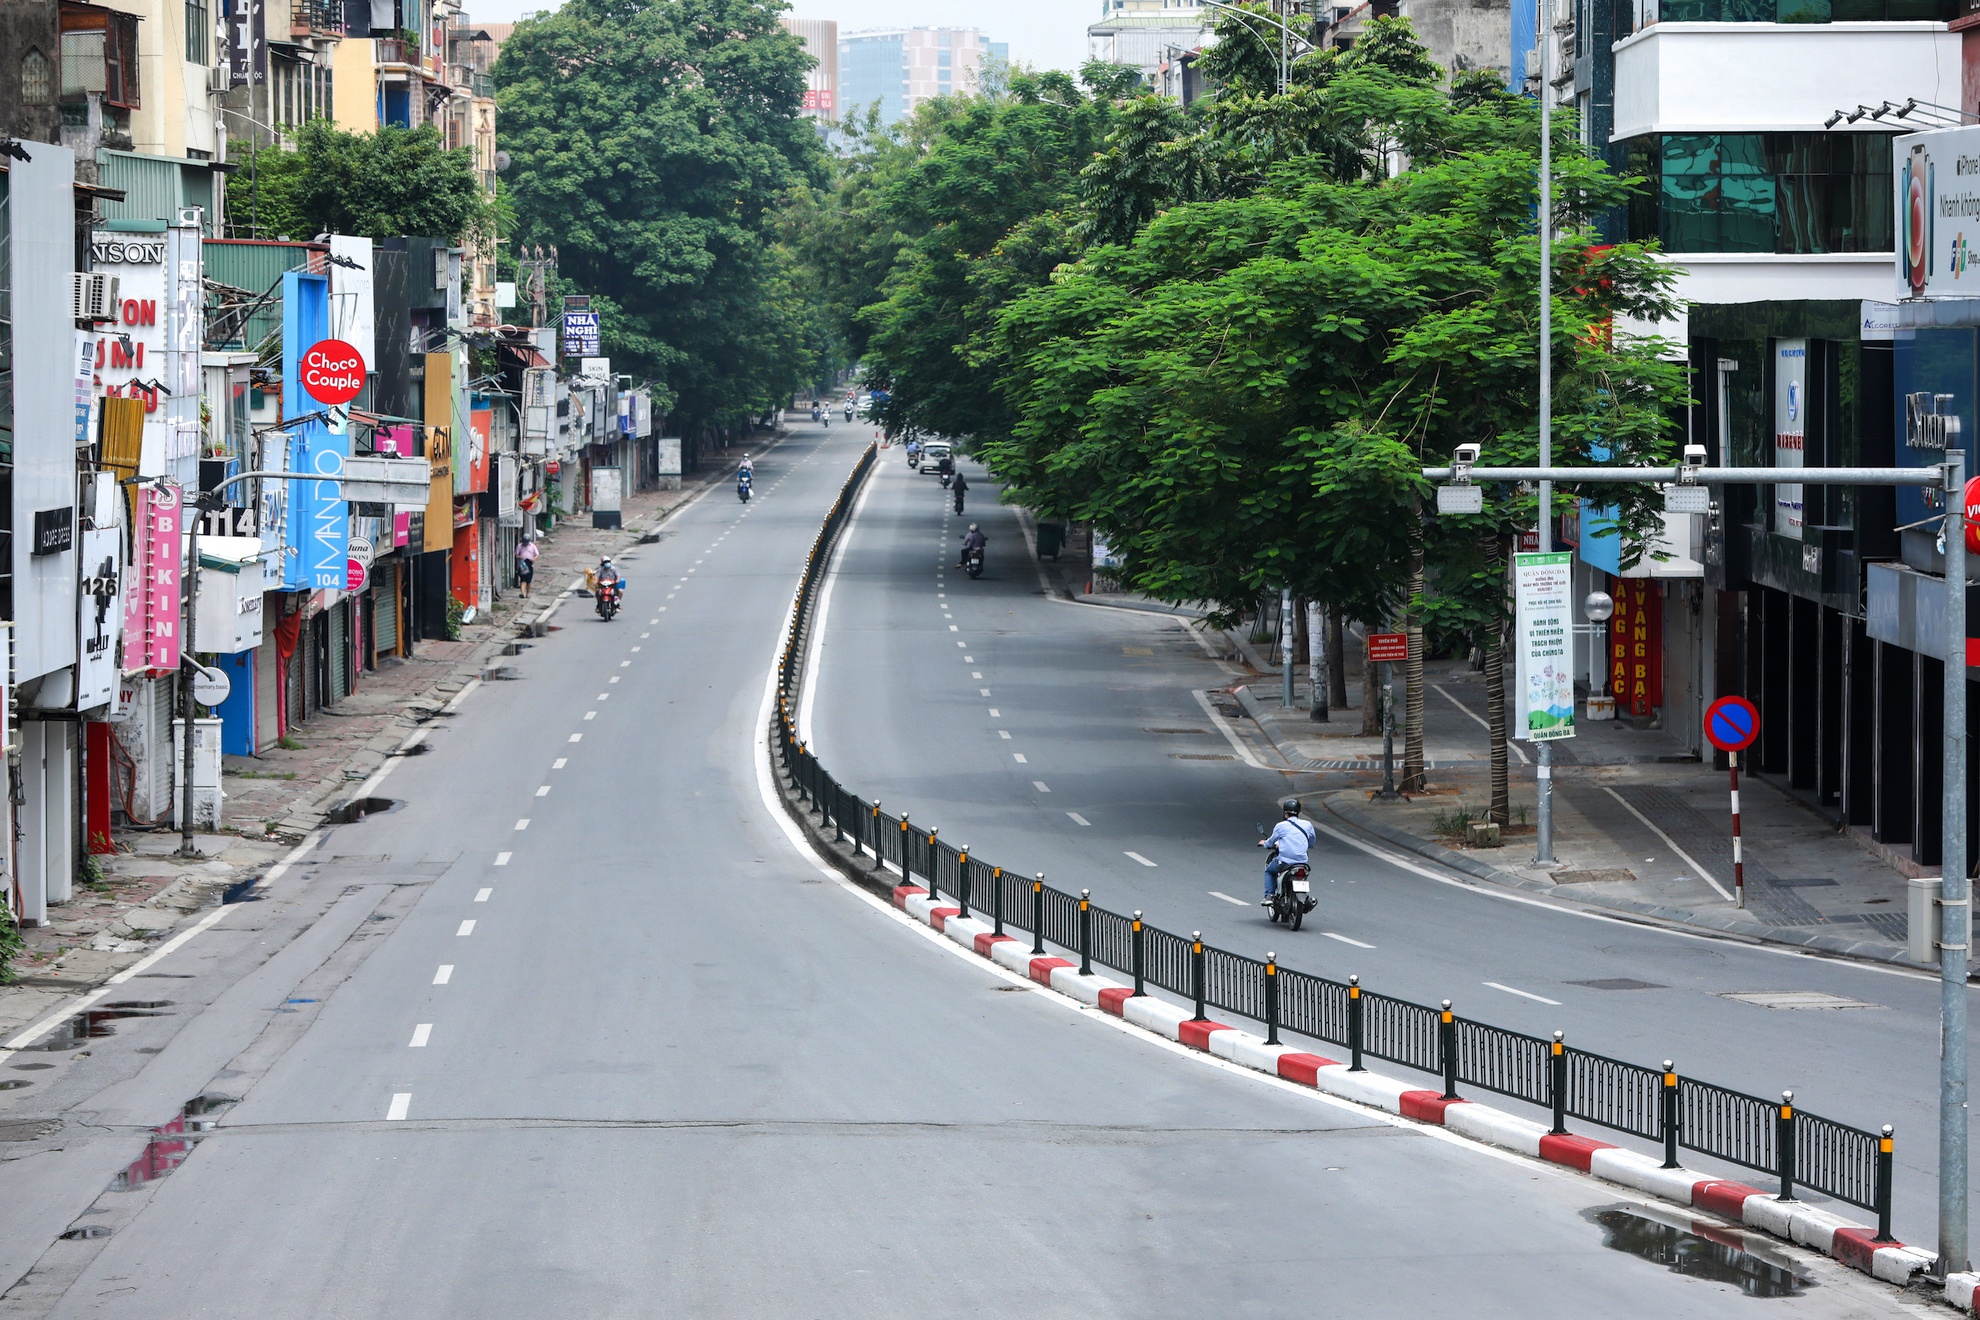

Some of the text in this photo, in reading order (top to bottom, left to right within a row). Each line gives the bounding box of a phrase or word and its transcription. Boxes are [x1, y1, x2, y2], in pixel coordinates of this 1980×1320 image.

[821, 100, 832, 108] QLO
[1940, 191, 1980, 222] Nhanh không
[308, 352, 358, 371] Choco
[306, 370, 361, 391] Couple
[205, 507, 257, 537] 114
[314, 449, 343, 570] MANDO
[82, 576, 117, 595] 126
[156, 517, 173, 664] BIKINI
[315, 574, 340, 587] 104
[1634, 592, 1646, 714] VÀNG BẠC
[1614, 644, 1625, 694] BẠC
[1534, 731, 1547, 739] QUẬN
[1549, 730, 1562, 738] ĐỐNG
